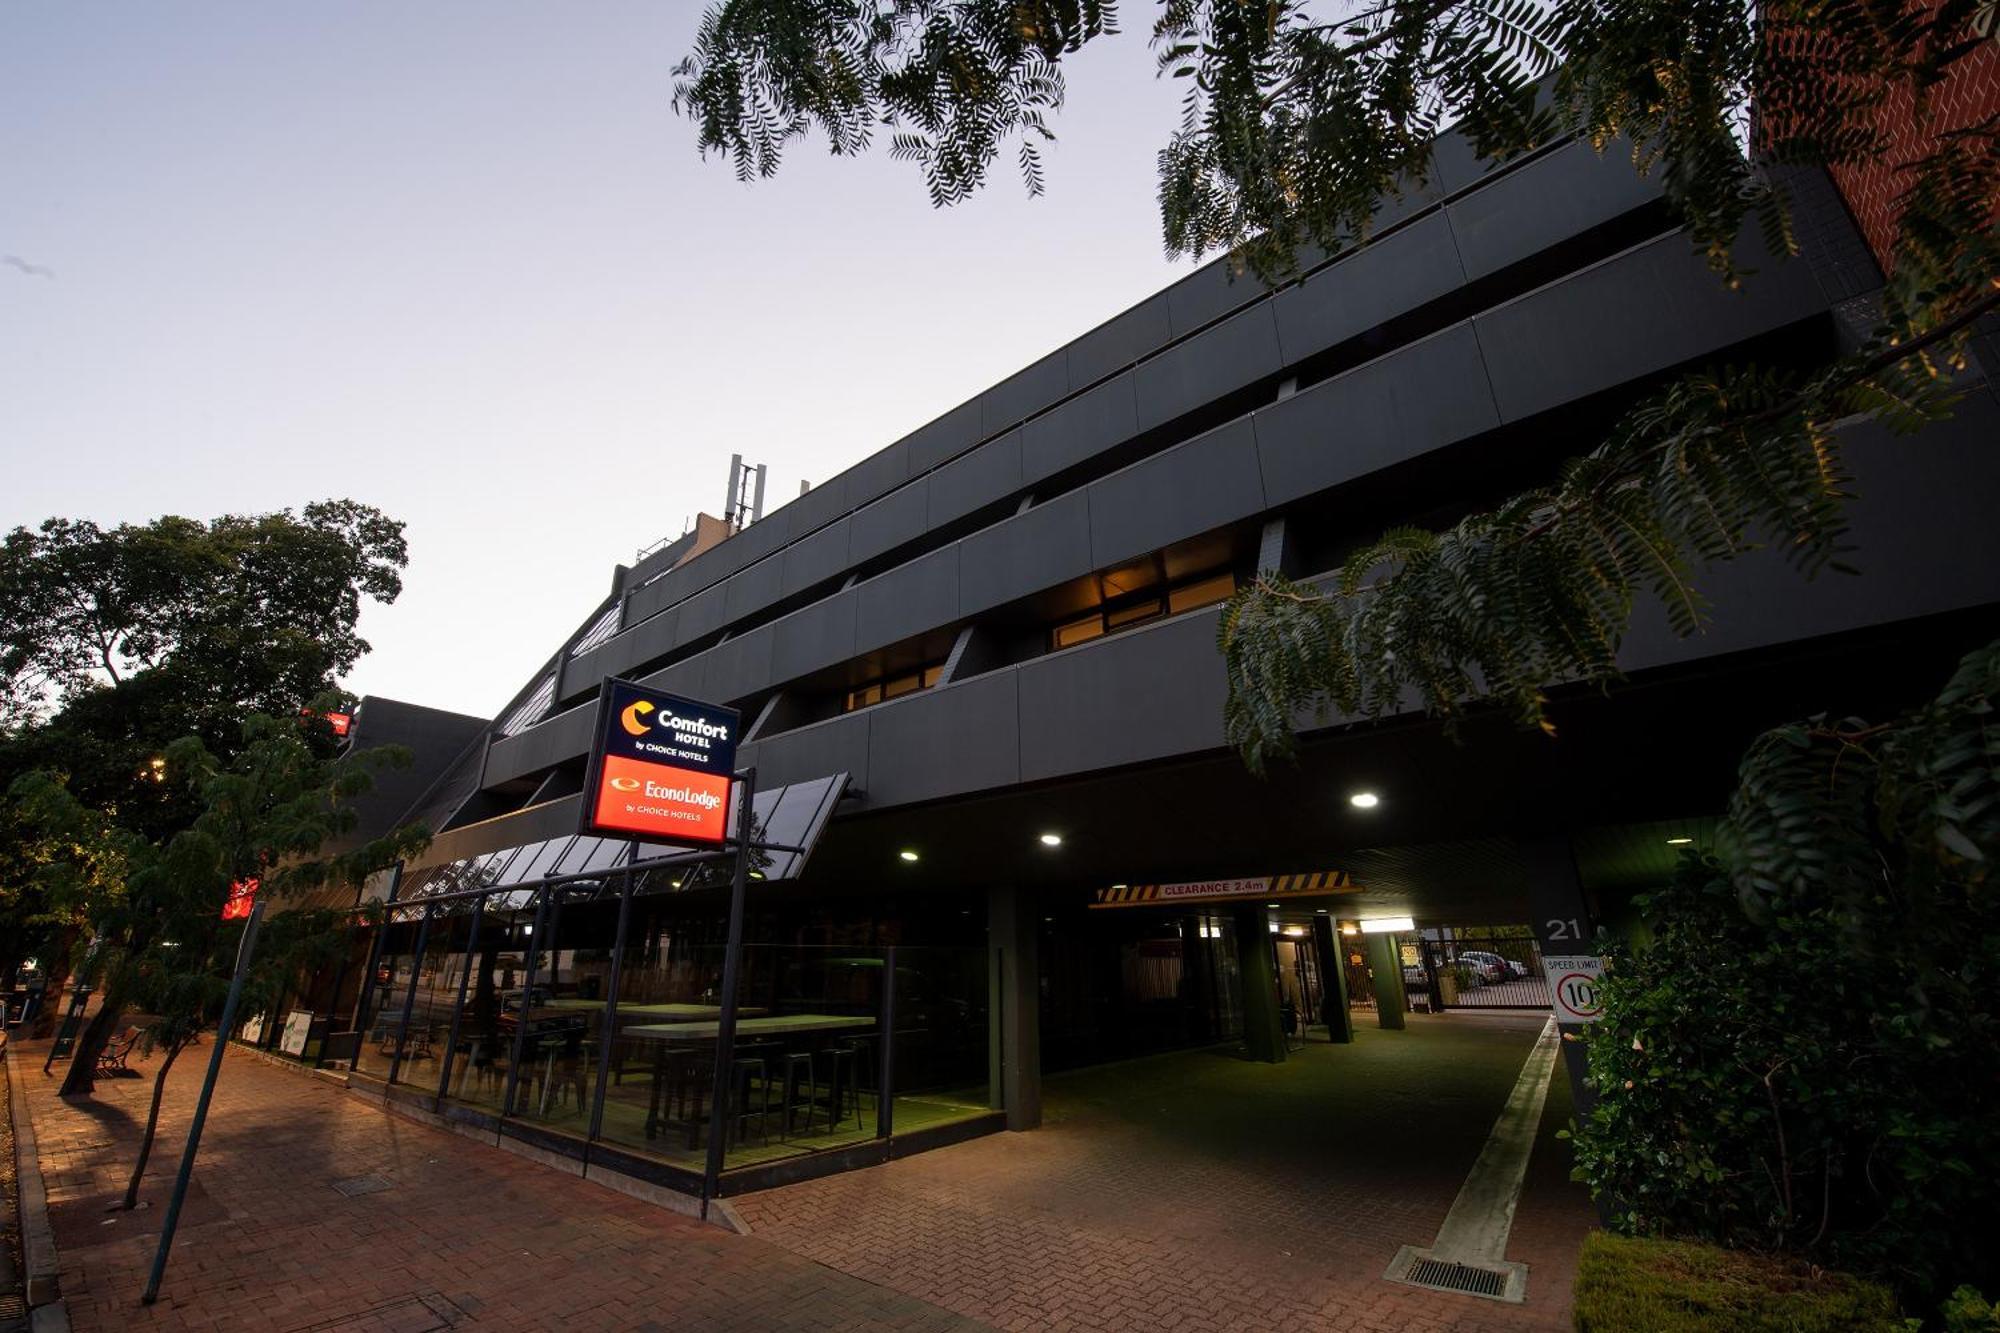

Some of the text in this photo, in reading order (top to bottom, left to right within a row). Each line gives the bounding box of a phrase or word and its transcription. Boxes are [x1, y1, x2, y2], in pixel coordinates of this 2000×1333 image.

[658, 710, 727, 740] Comfort
[675, 733, 710, 748] HOTEL
[635, 741, 708, 762] by CHOICE HOTELS
[645, 781, 720, 809] EconoLodge
[626, 804, 701, 822] by CHOICE HOTELS
[1165, 880, 1263, 896] CLEARANCE 2.4m
[1546, 918, 1581, 939] 21
[1548, 961, 1575, 969] SPEED
[1568, 983, 1594, 1008] 10
